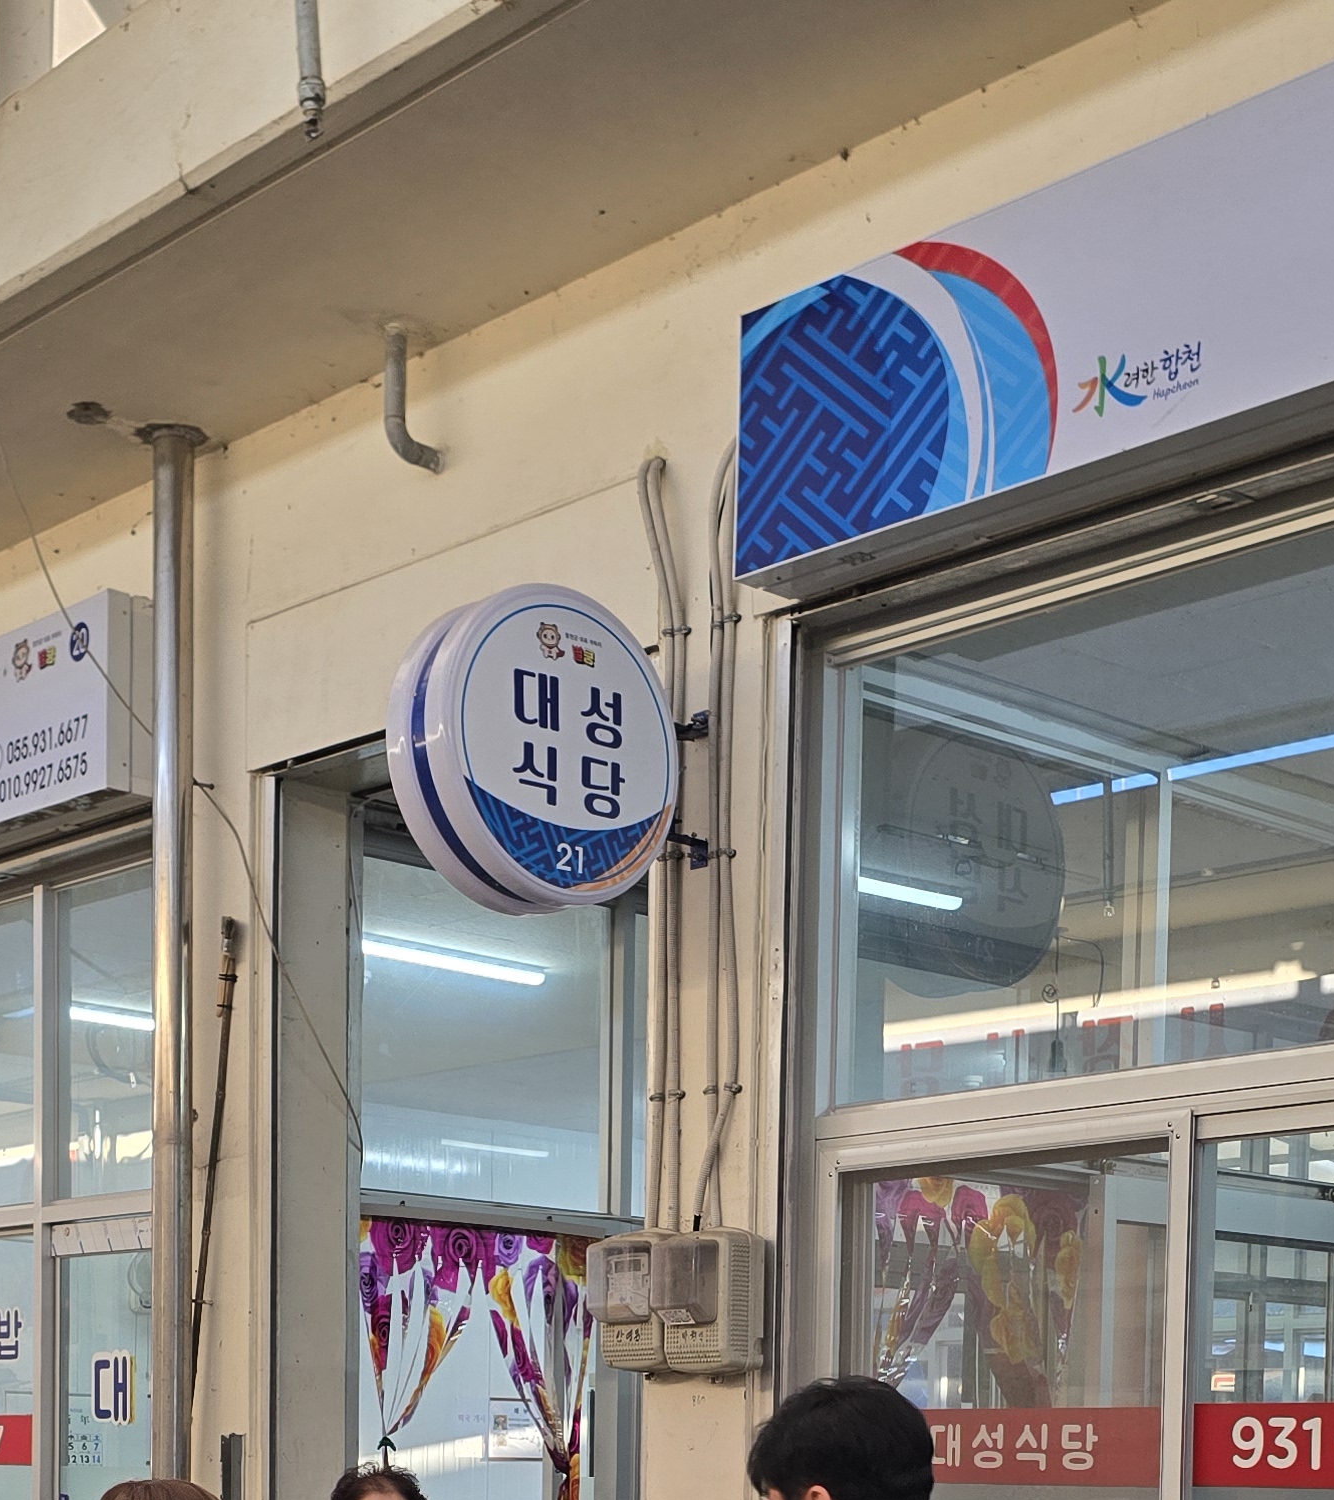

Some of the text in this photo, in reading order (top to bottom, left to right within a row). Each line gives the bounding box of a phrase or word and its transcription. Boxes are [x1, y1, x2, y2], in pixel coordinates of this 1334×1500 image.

[1160, 341, 1202, 382] 합천
[1153, 377, 1200, 401] Hapcheon
[513, 667, 622, 750] 대성
[7, 713, 89, 765] 055.931.6677
[0, 751, 87, 803] 010.9927.6575
[512, 741, 625, 820] 식당
[556, 843, 584, 874] 21
[94, 1355, 128, 1422] 대
[931, 1421, 1100, 1472] 대성식당
